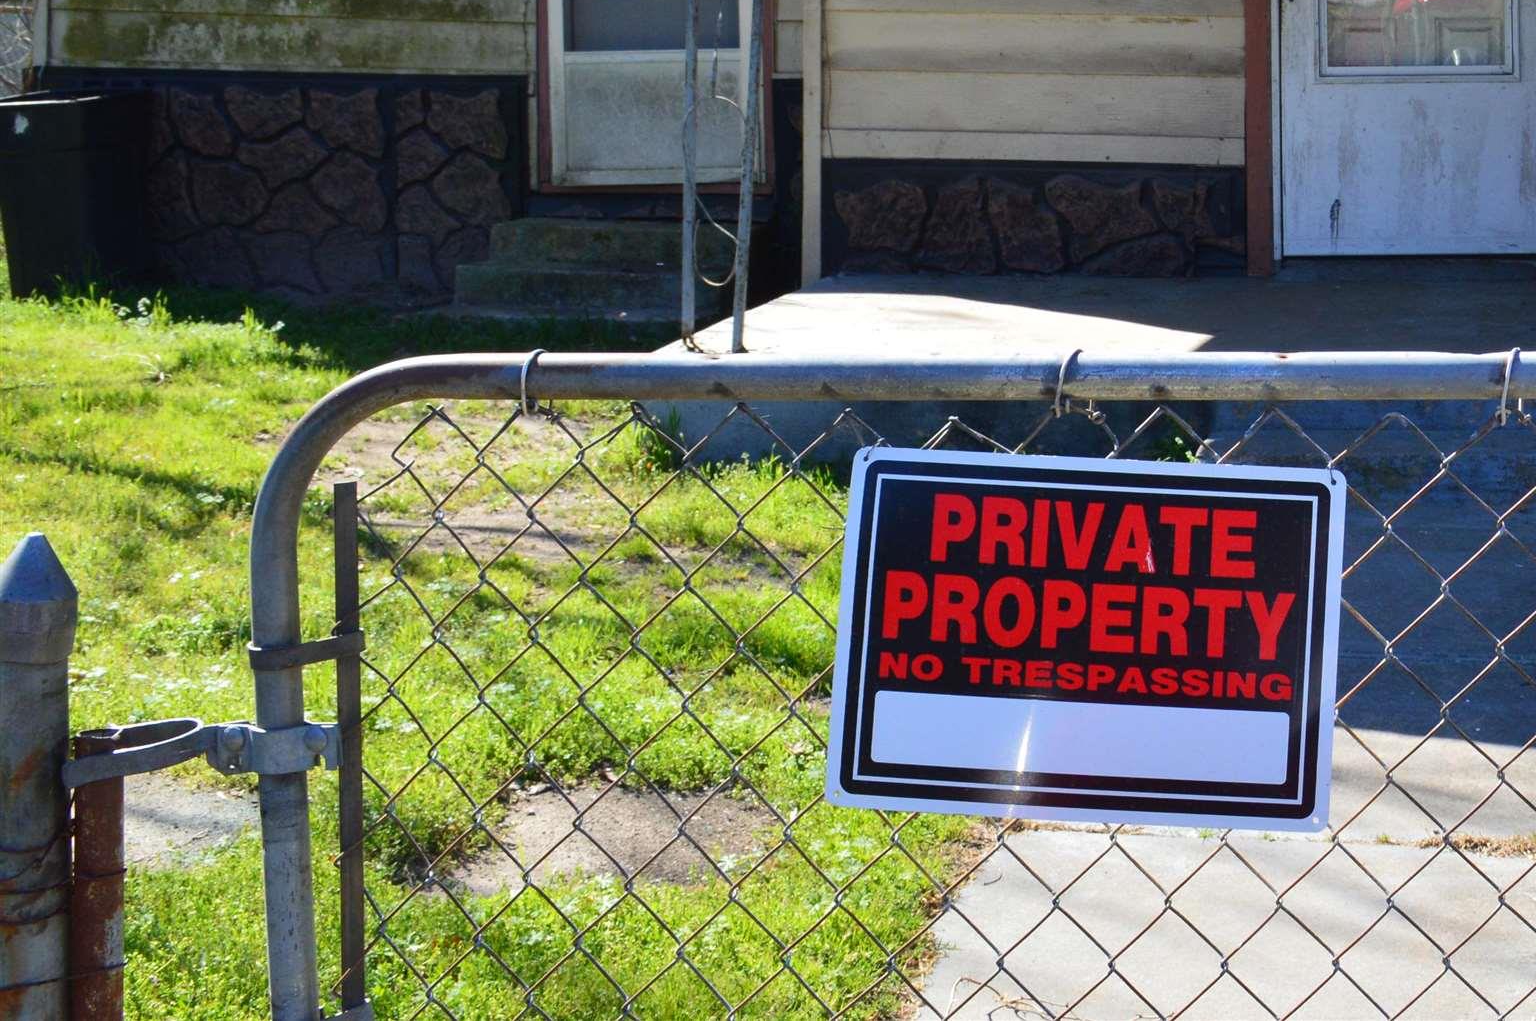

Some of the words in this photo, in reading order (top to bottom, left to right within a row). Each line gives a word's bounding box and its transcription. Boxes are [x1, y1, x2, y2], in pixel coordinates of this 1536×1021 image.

[930, 494, 1257, 578] PRIVATE
[882, 571, 1296, 660] PROPERTY
[878, 652, 944, 681] NO
[962, 657, 1293, 701] TRESPASSING
